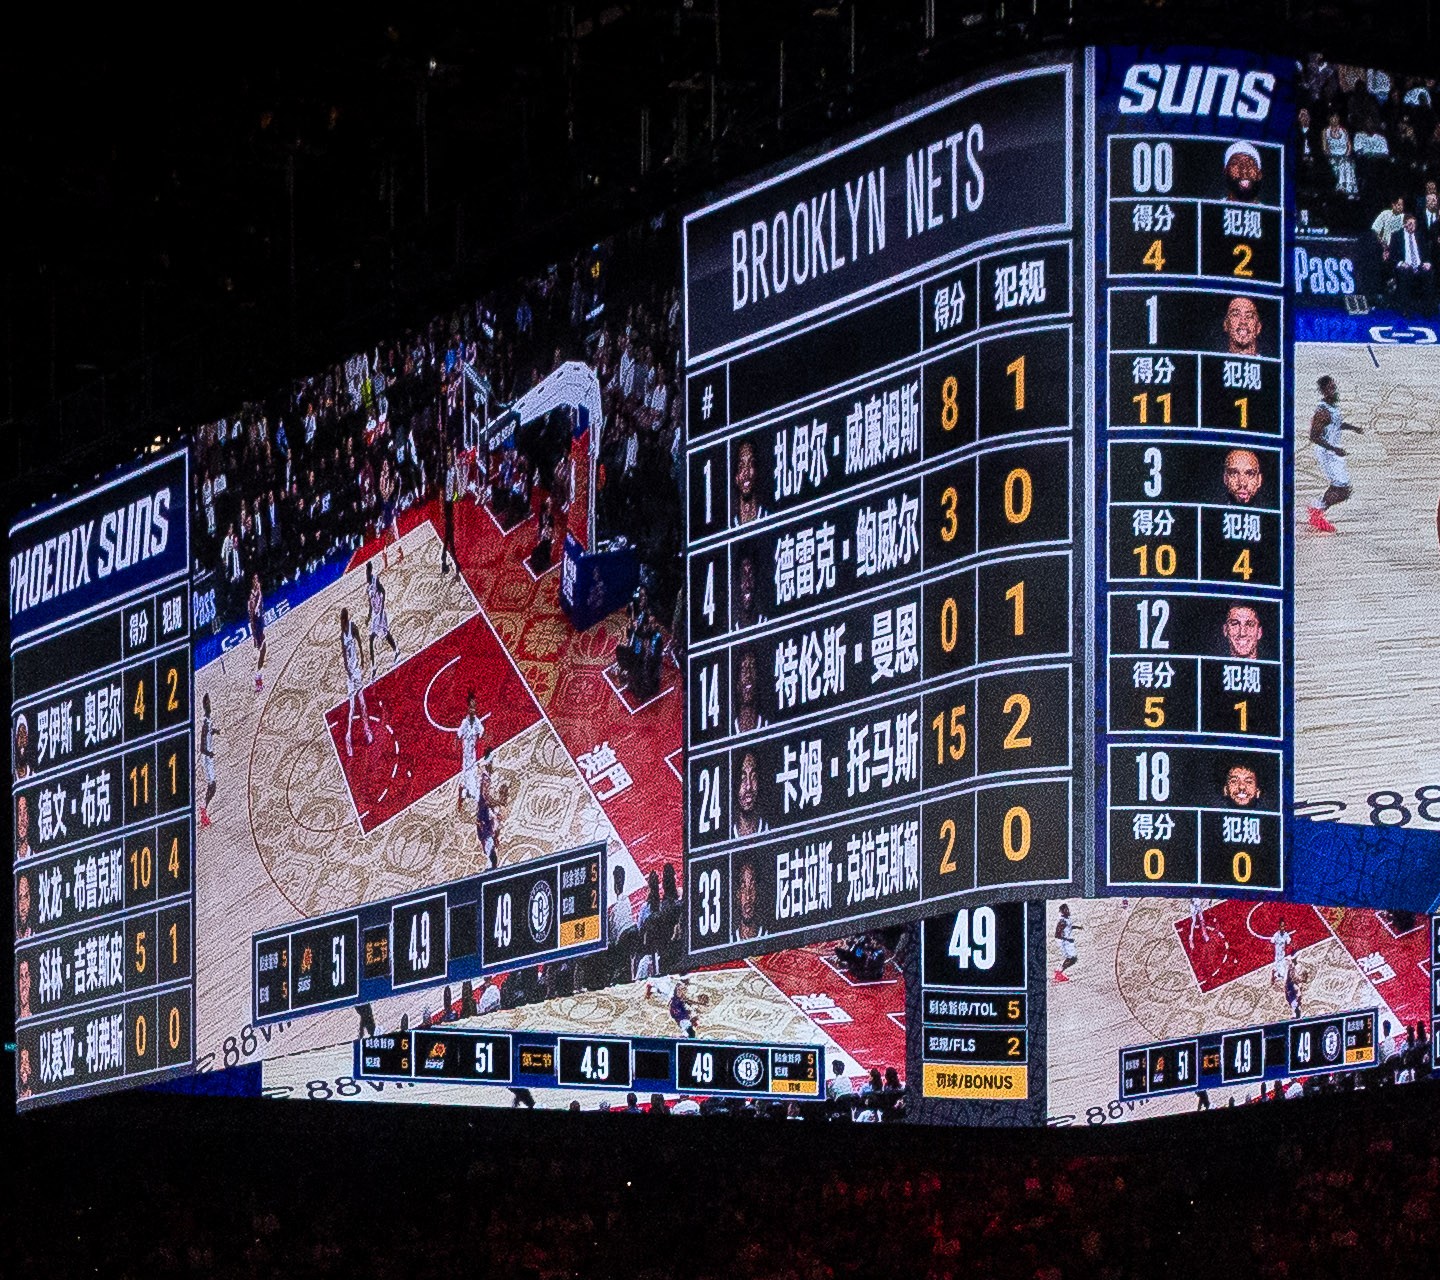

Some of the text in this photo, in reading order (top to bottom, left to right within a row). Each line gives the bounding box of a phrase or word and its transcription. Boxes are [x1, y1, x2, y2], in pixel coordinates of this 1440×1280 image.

[1118, 63, 1276, 122] SUNS
[1132, 141, 1174, 193] 00
[732, 123, 984, 312] BROOKLYN NETS
[1132, 204, 1262, 239] 得分 犯规
[1143, 240, 1254, 276] 4 2
[1294, 246, 1355, 295] Pass
[934, 260, 1046, 332] 得分 犯规
[1146, 295, 1158, 344] 1
[942, 376, 959, 431] 8
[1006, 355, 1025, 411] 1
[1132, 356, 1262, 390] 得分 犯规
[1132, 393, 1248, 428] 11 1
[1144, 447, 1162, 498] 3
[940, 487, 958, 542] 3
[1004, 468, 1032, 523] 0
[1132, 509, 1262, 542] 得分 犯规
[10, 488, 171, 614] PHOENIX SUNS
[1132, 544, 1253, 581] 10 4
[1137, 599, 1170, 650] 12
[699, 580, 1025, 731] 14 特伦斯·曼恩 0 1
[1132, 661, 1261, 693] 得分 犯规
[1144, 696, 1248, 732] 5 1
[698, 694, 1032, 834] 24 卡姆·托马斯 15 2
[1136, 751, 1170, 802] 18
[38, 763, 149, 843] 德文·布克 11
[1132, 814, 1261, 844] 得分 犯规
[130, 847, 151, 889] 10
[698, 869, 720, 936] 33
[939, 819, 957, 875] 2
[1003, 806, 1032, 862] 0
[1143, 848, 1252, 883] 0 0
[409, 911, 429, 971] 4.9
[949, 906, 996, 970] 49
[39, 931, 123, 1004] 科林·吉莱斯皮
[1007, 1001, 1020, 1019] 5
[475, 1042, 493, 1073] 51
[580, 1047, 609, 1080] 4.9
[691, 1053, 713, 1082] 49
[1007, 1037, 1020, 1056] 2
[1234, 1039, 1251, 1072] 4.9
[936, 1072, 1013, 1090] 罚球/BONUS
